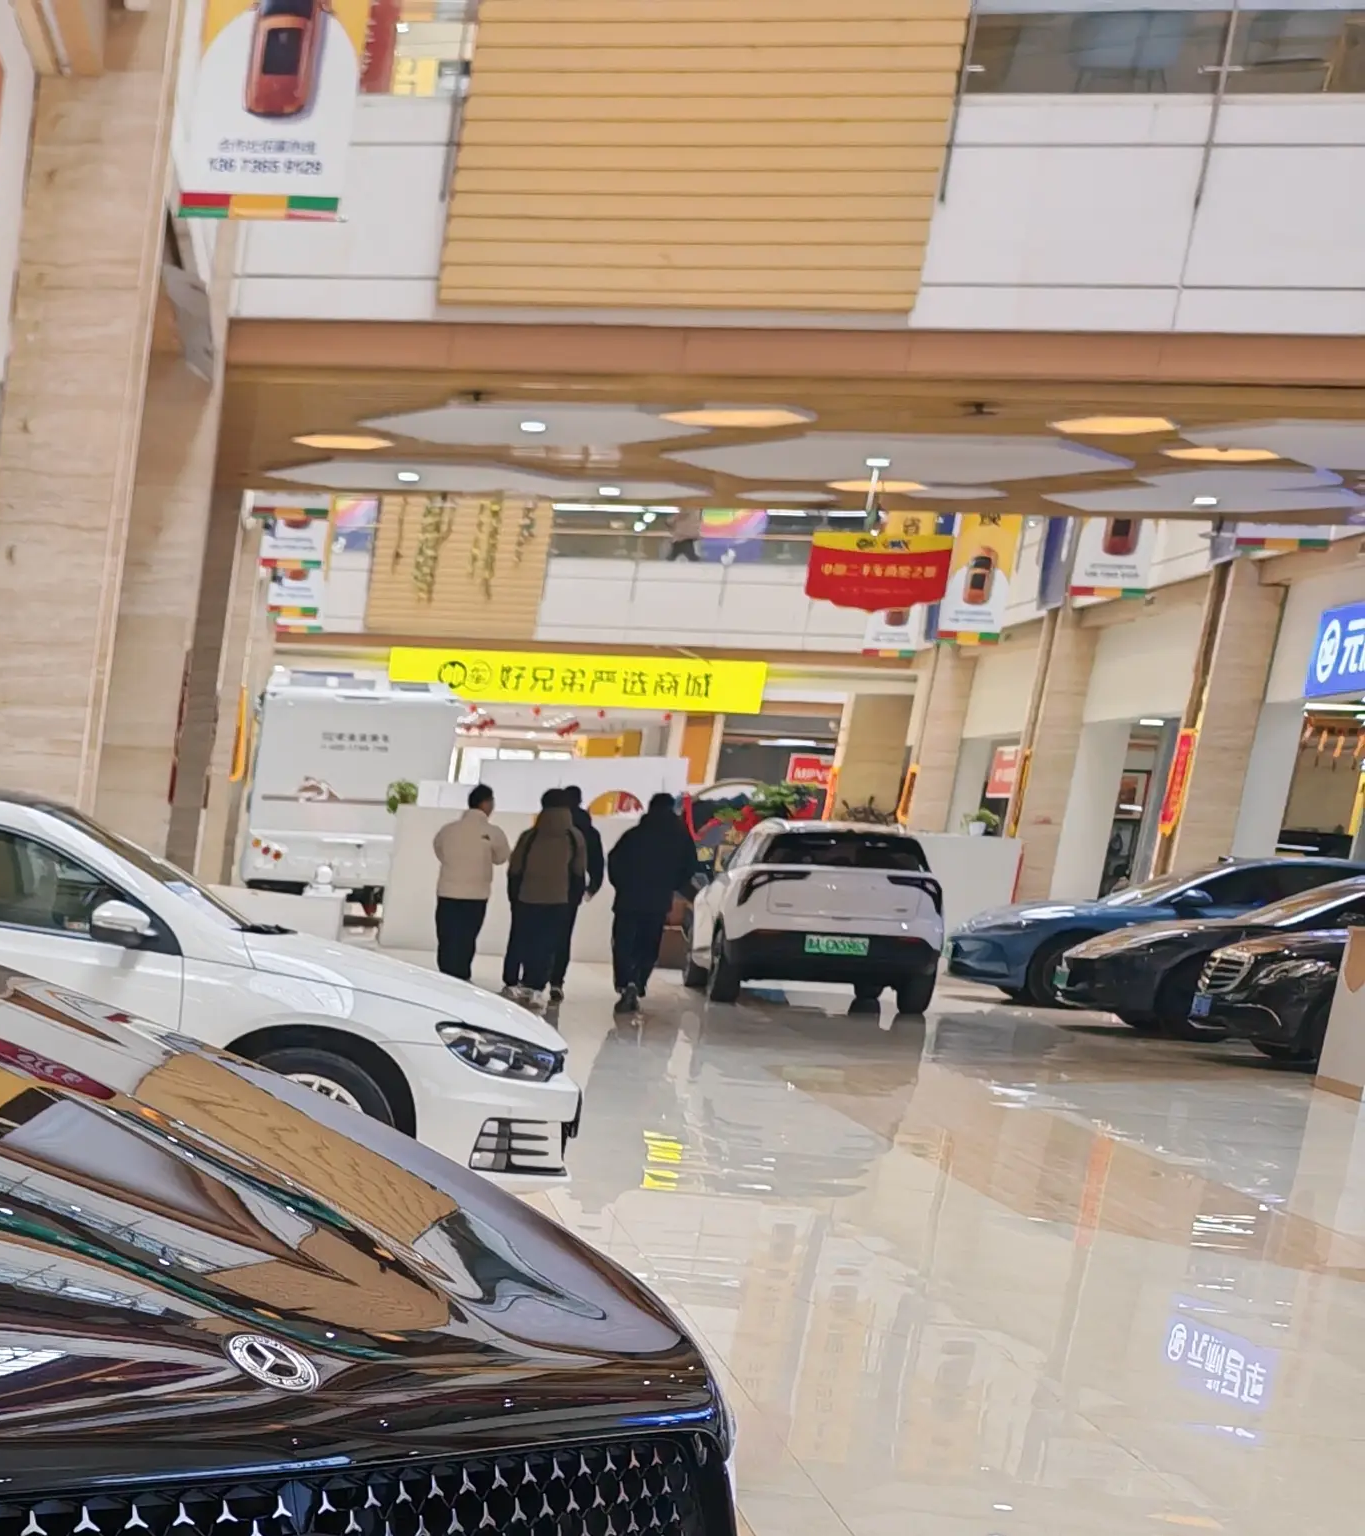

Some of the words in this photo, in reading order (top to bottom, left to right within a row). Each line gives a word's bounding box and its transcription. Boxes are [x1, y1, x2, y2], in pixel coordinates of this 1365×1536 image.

[498, 663, 713, 699] 好兄弟严选商城
